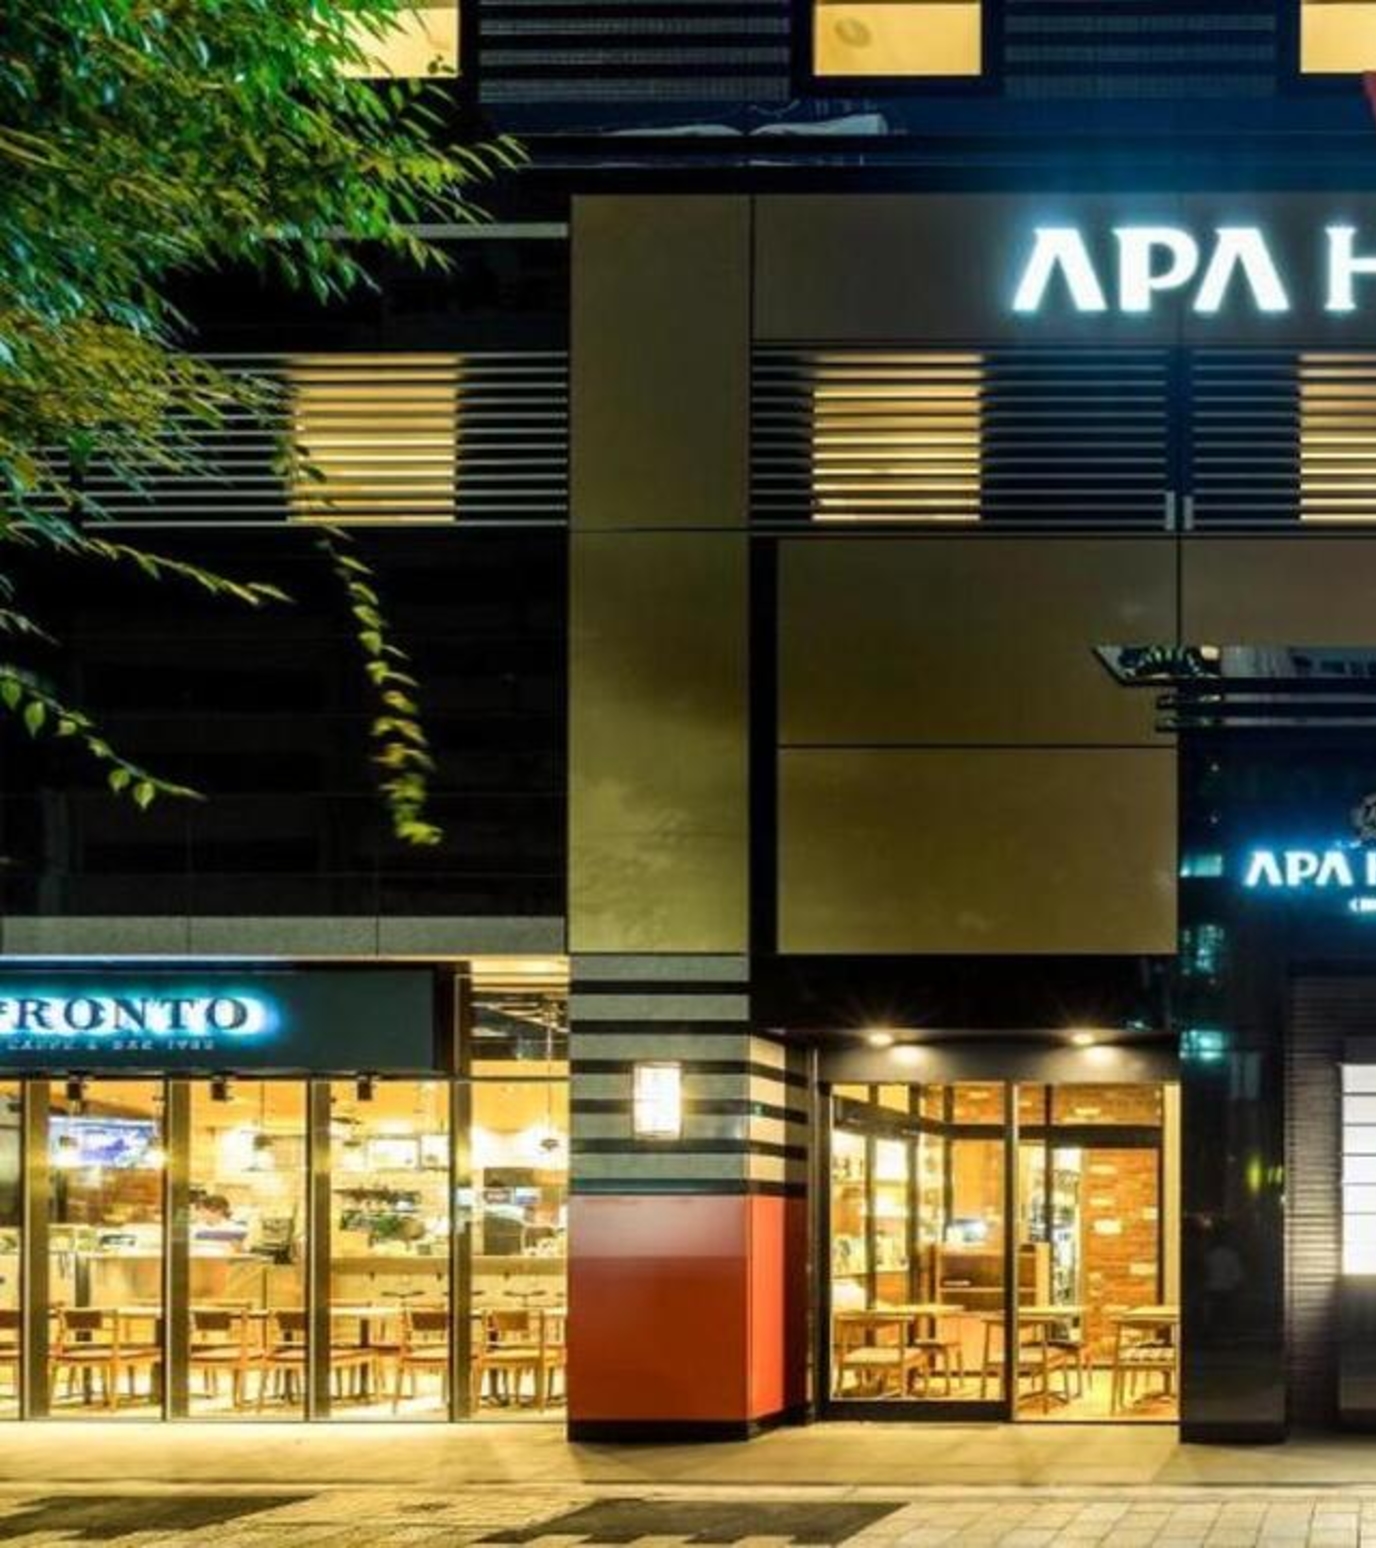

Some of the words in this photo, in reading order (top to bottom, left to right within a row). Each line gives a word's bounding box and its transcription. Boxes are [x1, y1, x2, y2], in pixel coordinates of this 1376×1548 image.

[1011, 226, 1290, 313] APA
[1244, 849, 1354, 886] APA
[0, 997, 249, 1031] RONTO
